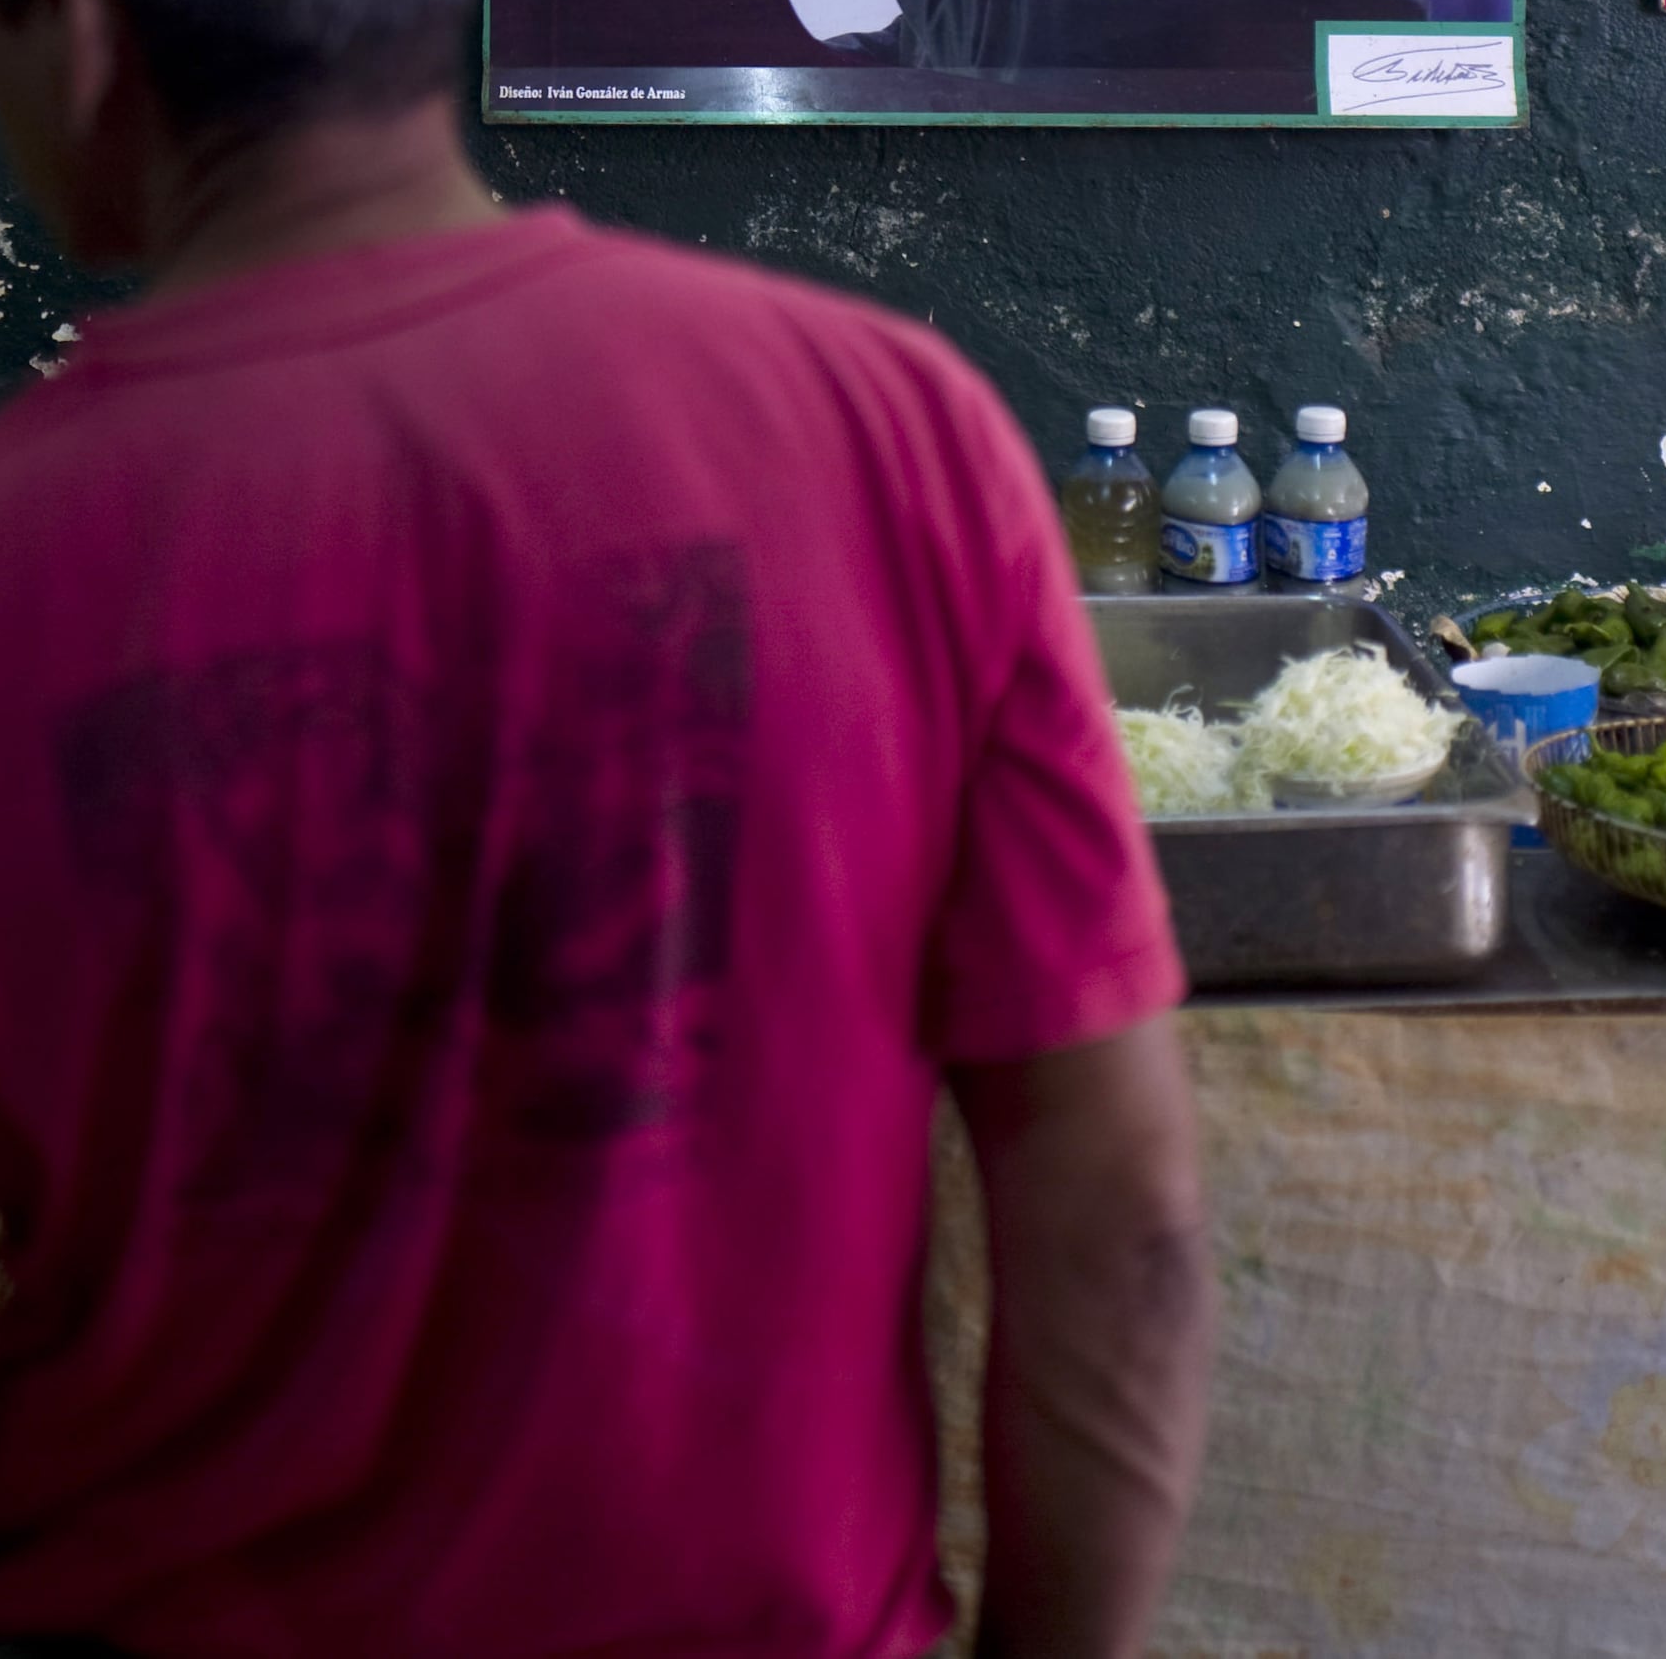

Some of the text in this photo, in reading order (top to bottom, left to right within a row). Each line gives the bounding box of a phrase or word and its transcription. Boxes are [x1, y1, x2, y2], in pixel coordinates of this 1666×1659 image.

[499, 85, 686, 100] Diseño: Iván González de Armas
